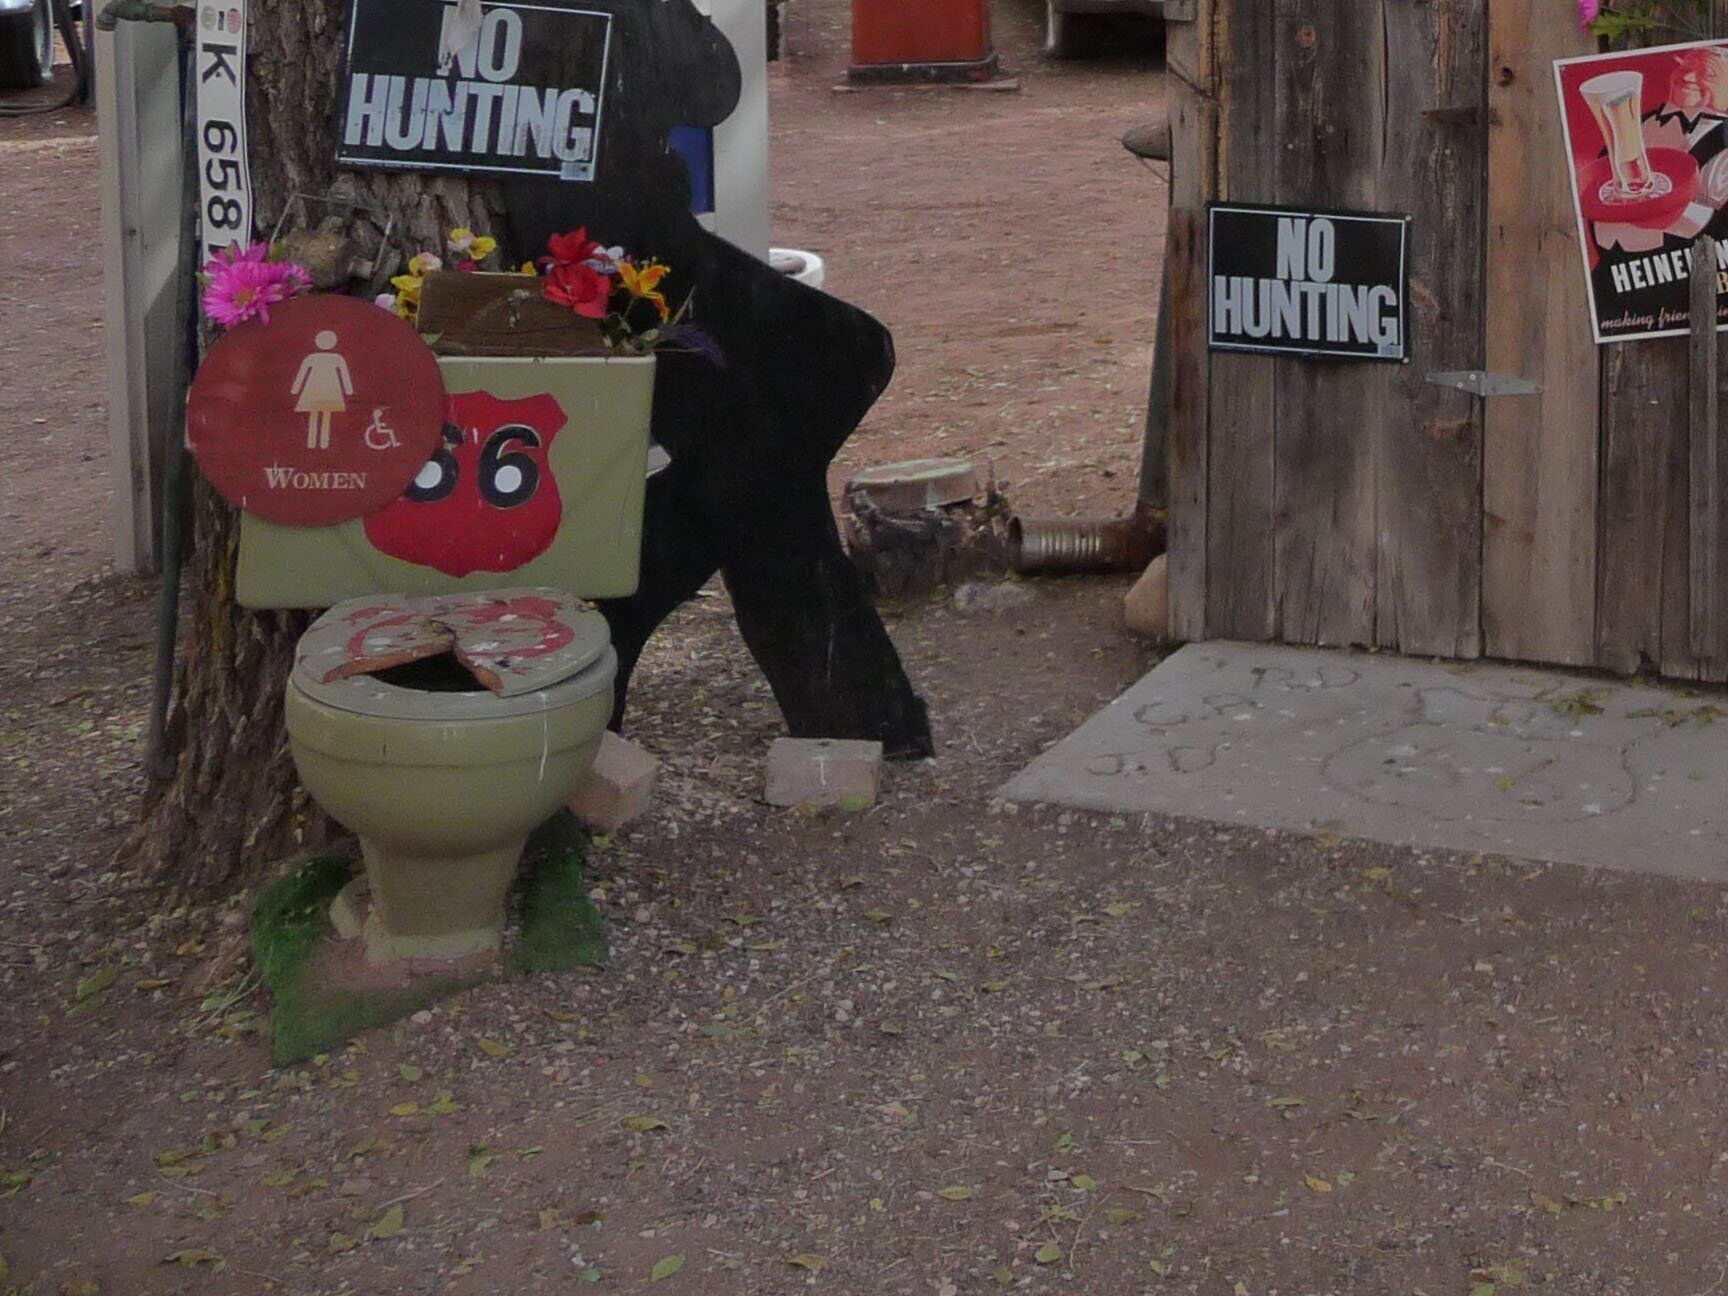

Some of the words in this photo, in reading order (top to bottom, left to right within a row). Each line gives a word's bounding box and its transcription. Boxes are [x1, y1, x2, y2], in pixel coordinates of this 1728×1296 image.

[344, 72, 596, 162] HUNTING
[202, 118, 244, 261] 658
[1275, 216, 1336, 284] NO
[1213, 274, 1399, 345] HUNTING
[1601, 310, 1655, 330] making
